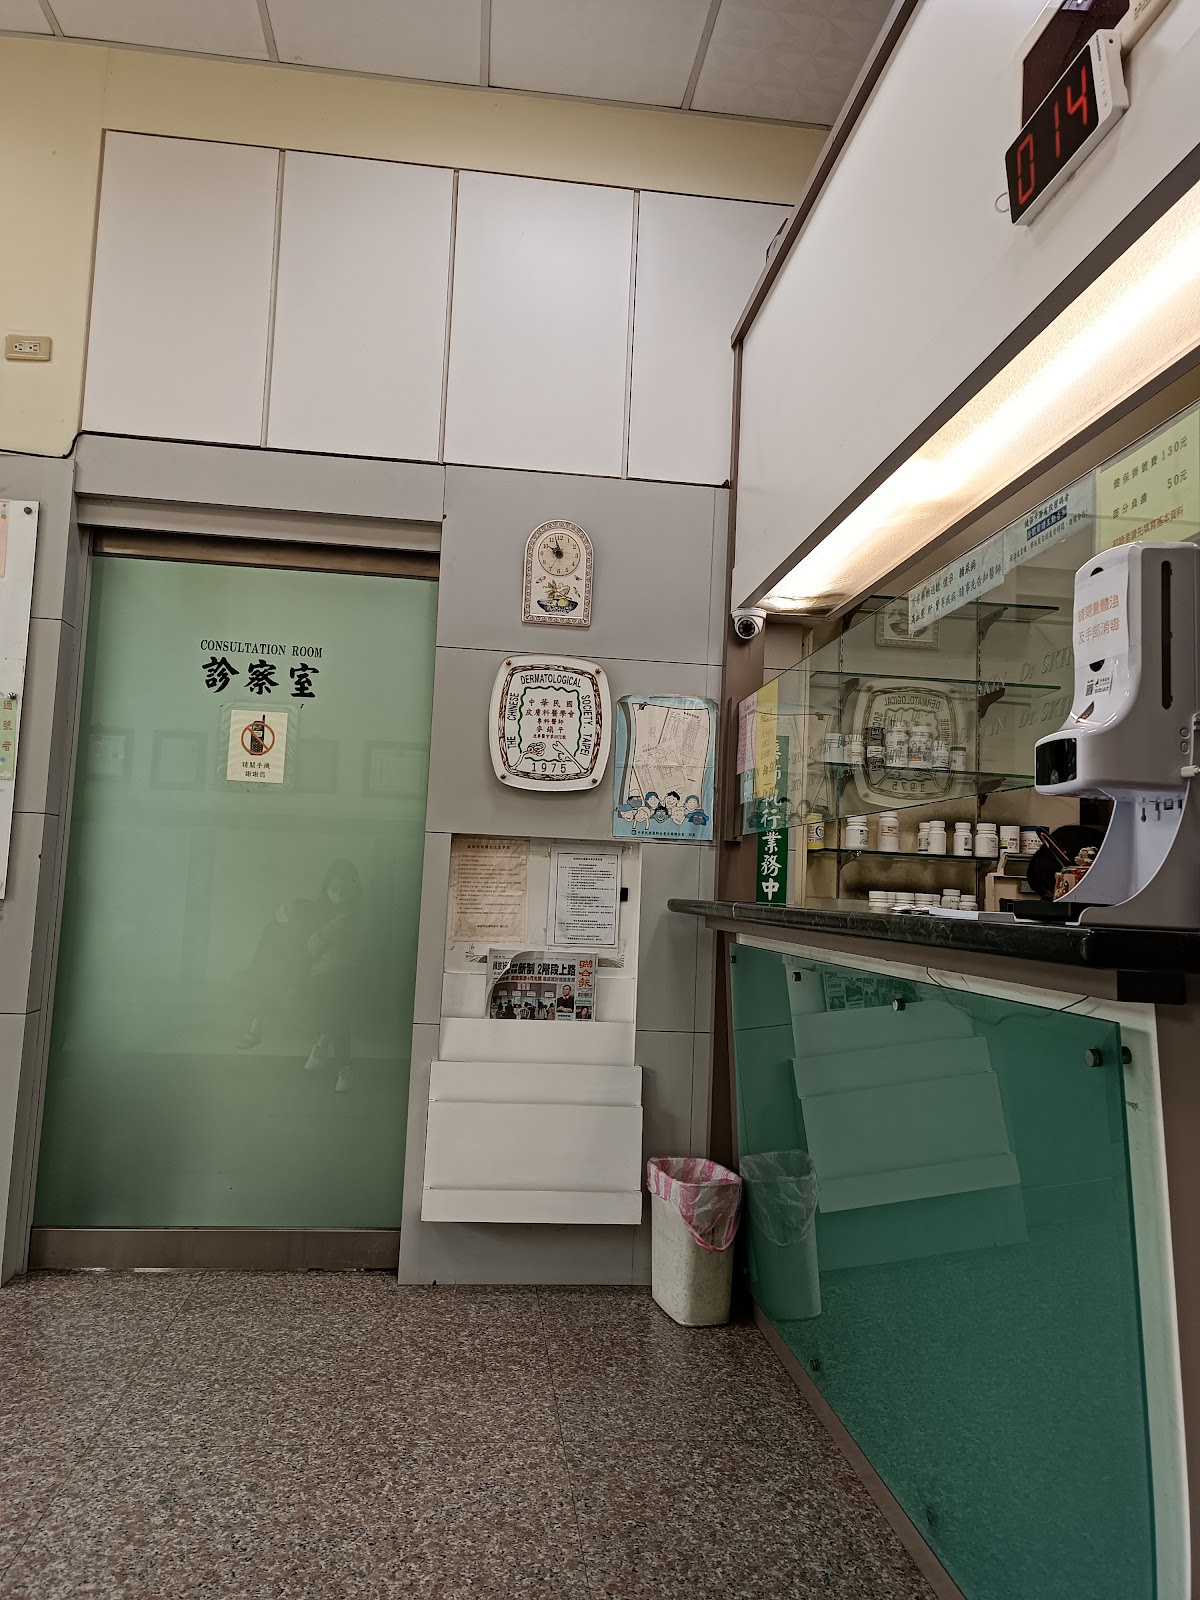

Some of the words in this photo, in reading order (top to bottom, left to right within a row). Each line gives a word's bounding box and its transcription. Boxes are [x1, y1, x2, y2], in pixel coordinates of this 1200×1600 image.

[1016, 66, 1087, 205] 014
[1162, 436, 1188, 461] 130元
[1112, 493, 1147, 519] 部分負擔
[1167, 469, 1188, 489] 50元
[1078, 617, 1119, 646] 及手部消毒
[200, 639, 287, 656] CONSULTATION
[292, 645, 323, 658] ROOM
[201, 656, 320, 698] 診察室
[520, 673, 581, 688] DERMATOLOGICAL
[507, 692, 520, 721] CHINESE
[525, 708, 575, 719] 皮膚科醫學會
[528, 698, 573, 708] 中華民國
[537, 718, 564, 726] 專科醫師
[506, 735, 517, 750] THE
[580, 733, 593, 757] TAIPEI
[531, 762, 567, 773] 1975
[578, 959, 593, 988] 聯合報
